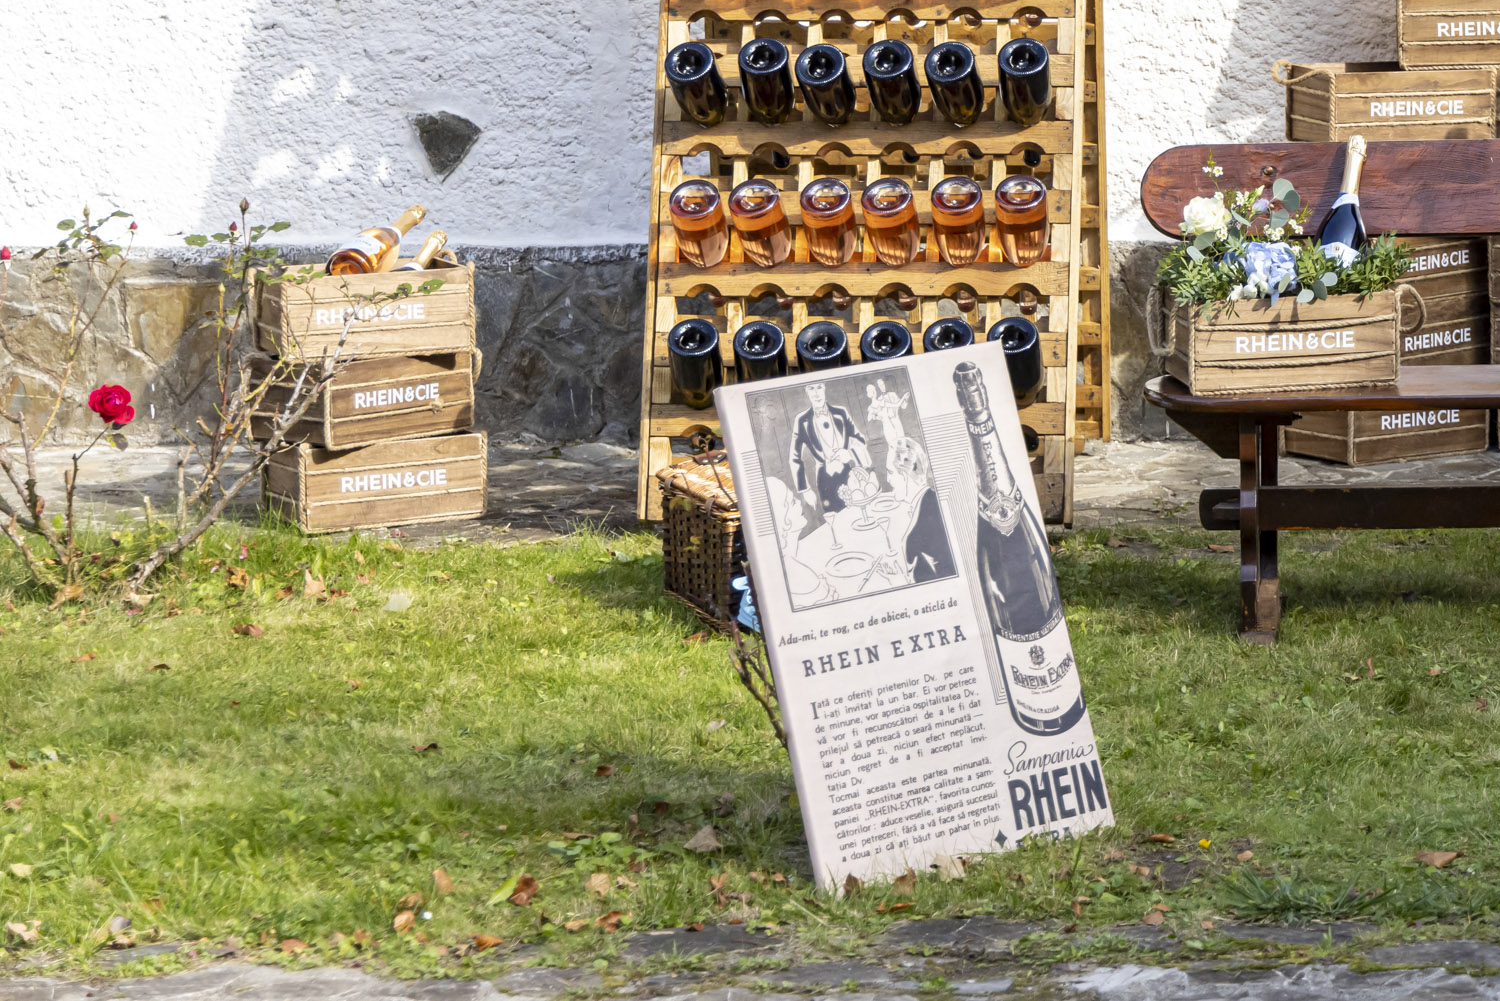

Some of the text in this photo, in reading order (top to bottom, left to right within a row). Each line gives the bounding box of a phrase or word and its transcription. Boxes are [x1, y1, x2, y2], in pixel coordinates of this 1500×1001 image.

[1370, 99, 1464, 117] RHEIN&CIE
[1401, 250, 1470, 272] HEIN&CIE
[1235, 331, 1355, 353] RHEIN&CIE
[1405, 327, 1471, 352] RHEIN&CIE
[354, 383, 440, 408] RHEIN&CIE
[968, 418, 994, 435] RHEIN
[1381, 409, 1460, 430] RHEIN&CIE
[983, 441, 998, 482] Extra
[340, 469, 447, 493] RHEIN&CIE
[819, 629, 828, 638] te
[853, 621, 865, 630] ca
[867, 615, 879, 626] de
[947, 597, 958, 608] de
[801, 625, 967, 677] RHEIN EXTRA
[833, 696, 843, 704] ce
[877, 678, 920, 696] prietenilor
[943, 670, 953, 680] pe
[958, 666, 974, 675] care
[876, 698, 884, 706] la
[888, 696, 899, 704] un
[922, 686, 930, 695] Ei
[933, 684, 947, 692] vor
[948, 677, 976, 691] petrece
[814, 724, 825, 734] de
[865, 712, 878, 721] vor
[881, 704, 911, 718] aprecia
[912, 693, 961, 710] ospitalitatea
[832, 732, 846, 741] vor
[851, 727, 858, 736] fi
[923, 710, 934, 720] de
[947, 705, 955, 713] le
[958, 702, 965, 711] fi
[968, 699, 981, 709] dat
[819, 742, 849, 758] prilejul
[822, 760, 833, 769] iar
[851, 751, 871, 762] doua
[893, 740, 919, 751] niciun
[925, 732, 945, 744] efect
[824, 740, 963, 780] niciun regret de fi acceptat
[828, 791, 860, 803] Tocmai
[866, 782, 896, 795] aceasta
[900, 776, 917, 786] este
[922, 768, 948, 782] partea
[832, 802, 862, 816] aceasta
[865, 792, 903, 807] constitue
[906, 785, 931, 796] marea
[933, 776, 964, 790] calitate
[1007, 759, 1107, 831] RHEIN
[834, 816, 859, 829] paniei
[939, 787, 970, 800] favorita
[880, 816, 903, 828] aduce
[966, 789, 998, 806] succesul
[839, 839, 857, 851] unei
[938, 815, 955, 824] face
[850, 850, 871, 860] doua
[874, 845, 882, 854] zi
[934, 830, 946, 838] un
[948, 823, 970, 836] pahar
